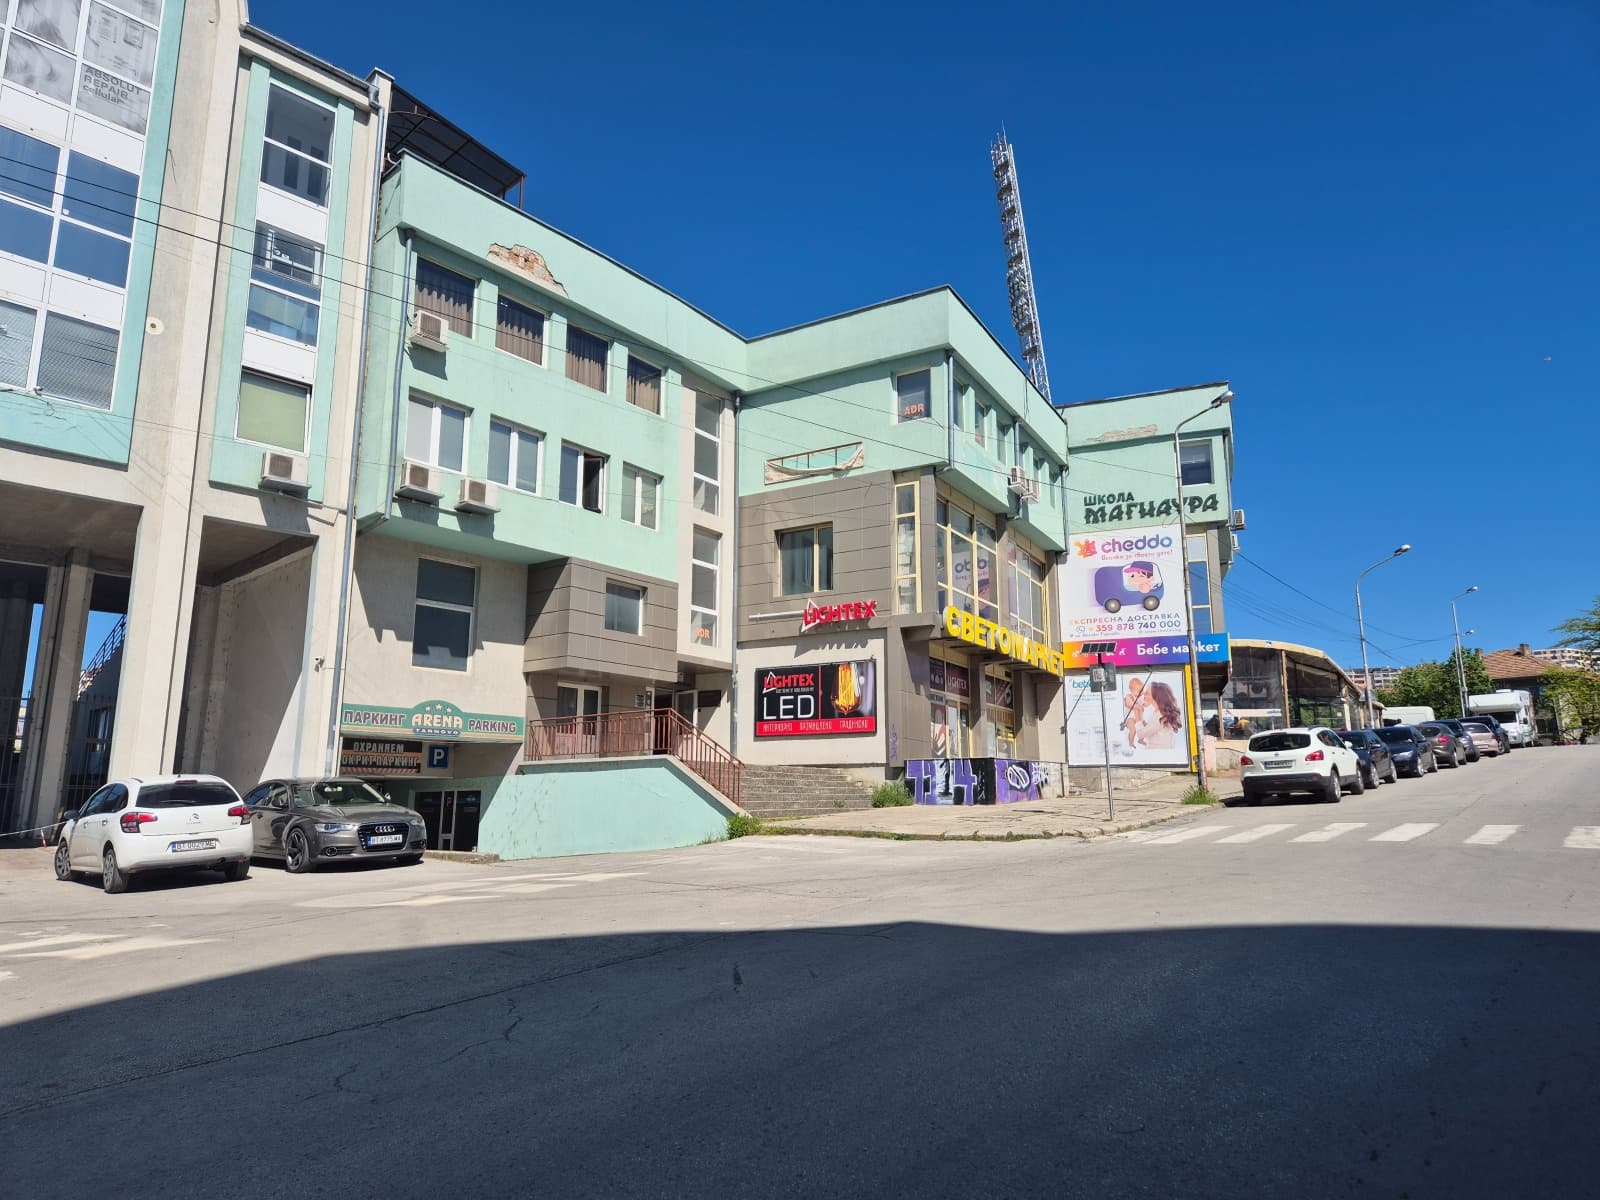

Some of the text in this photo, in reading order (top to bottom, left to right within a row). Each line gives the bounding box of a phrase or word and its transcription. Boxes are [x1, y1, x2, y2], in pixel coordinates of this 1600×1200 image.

[84, 74, 129, 100] REPAIR
[85, 67, 140, 96] ABSOLUT
[83, 85, 120, 104] cellular
[904, 403, 925, 416] ADR
[1084, 492, 1134, 506] ШКОЛА
[1084, 494, 1219, 524] МАГНАУРА
[1101, 534, 1172, 553] cheddo
[803, 600, 877, 626] LIGHTEX
[1070, 613, 1180, 625] ЕКСПРЕСНА ДОСТАВКА
[1116, 623, 1134, 631] 878
[1138, 621, 1156, 629] 740
[1160, 620, 1181, 628] 000
[944, 605, 1065, 678] СВЕТОМАРКЕТ
[1137, 643, 1168, 656] Бебе
[764, 673, 814, 689] LIGHTEX
[763, 695, 814, 720] LED
[343, 710, 406, 726] ПАРКИНГ
[412, 713, 463, 729] ARENA
[468, 719, 516, 733] PARKING
[377, 756, 418, 767] ПАРКИНГ
[433, 748, 444, 766] P
